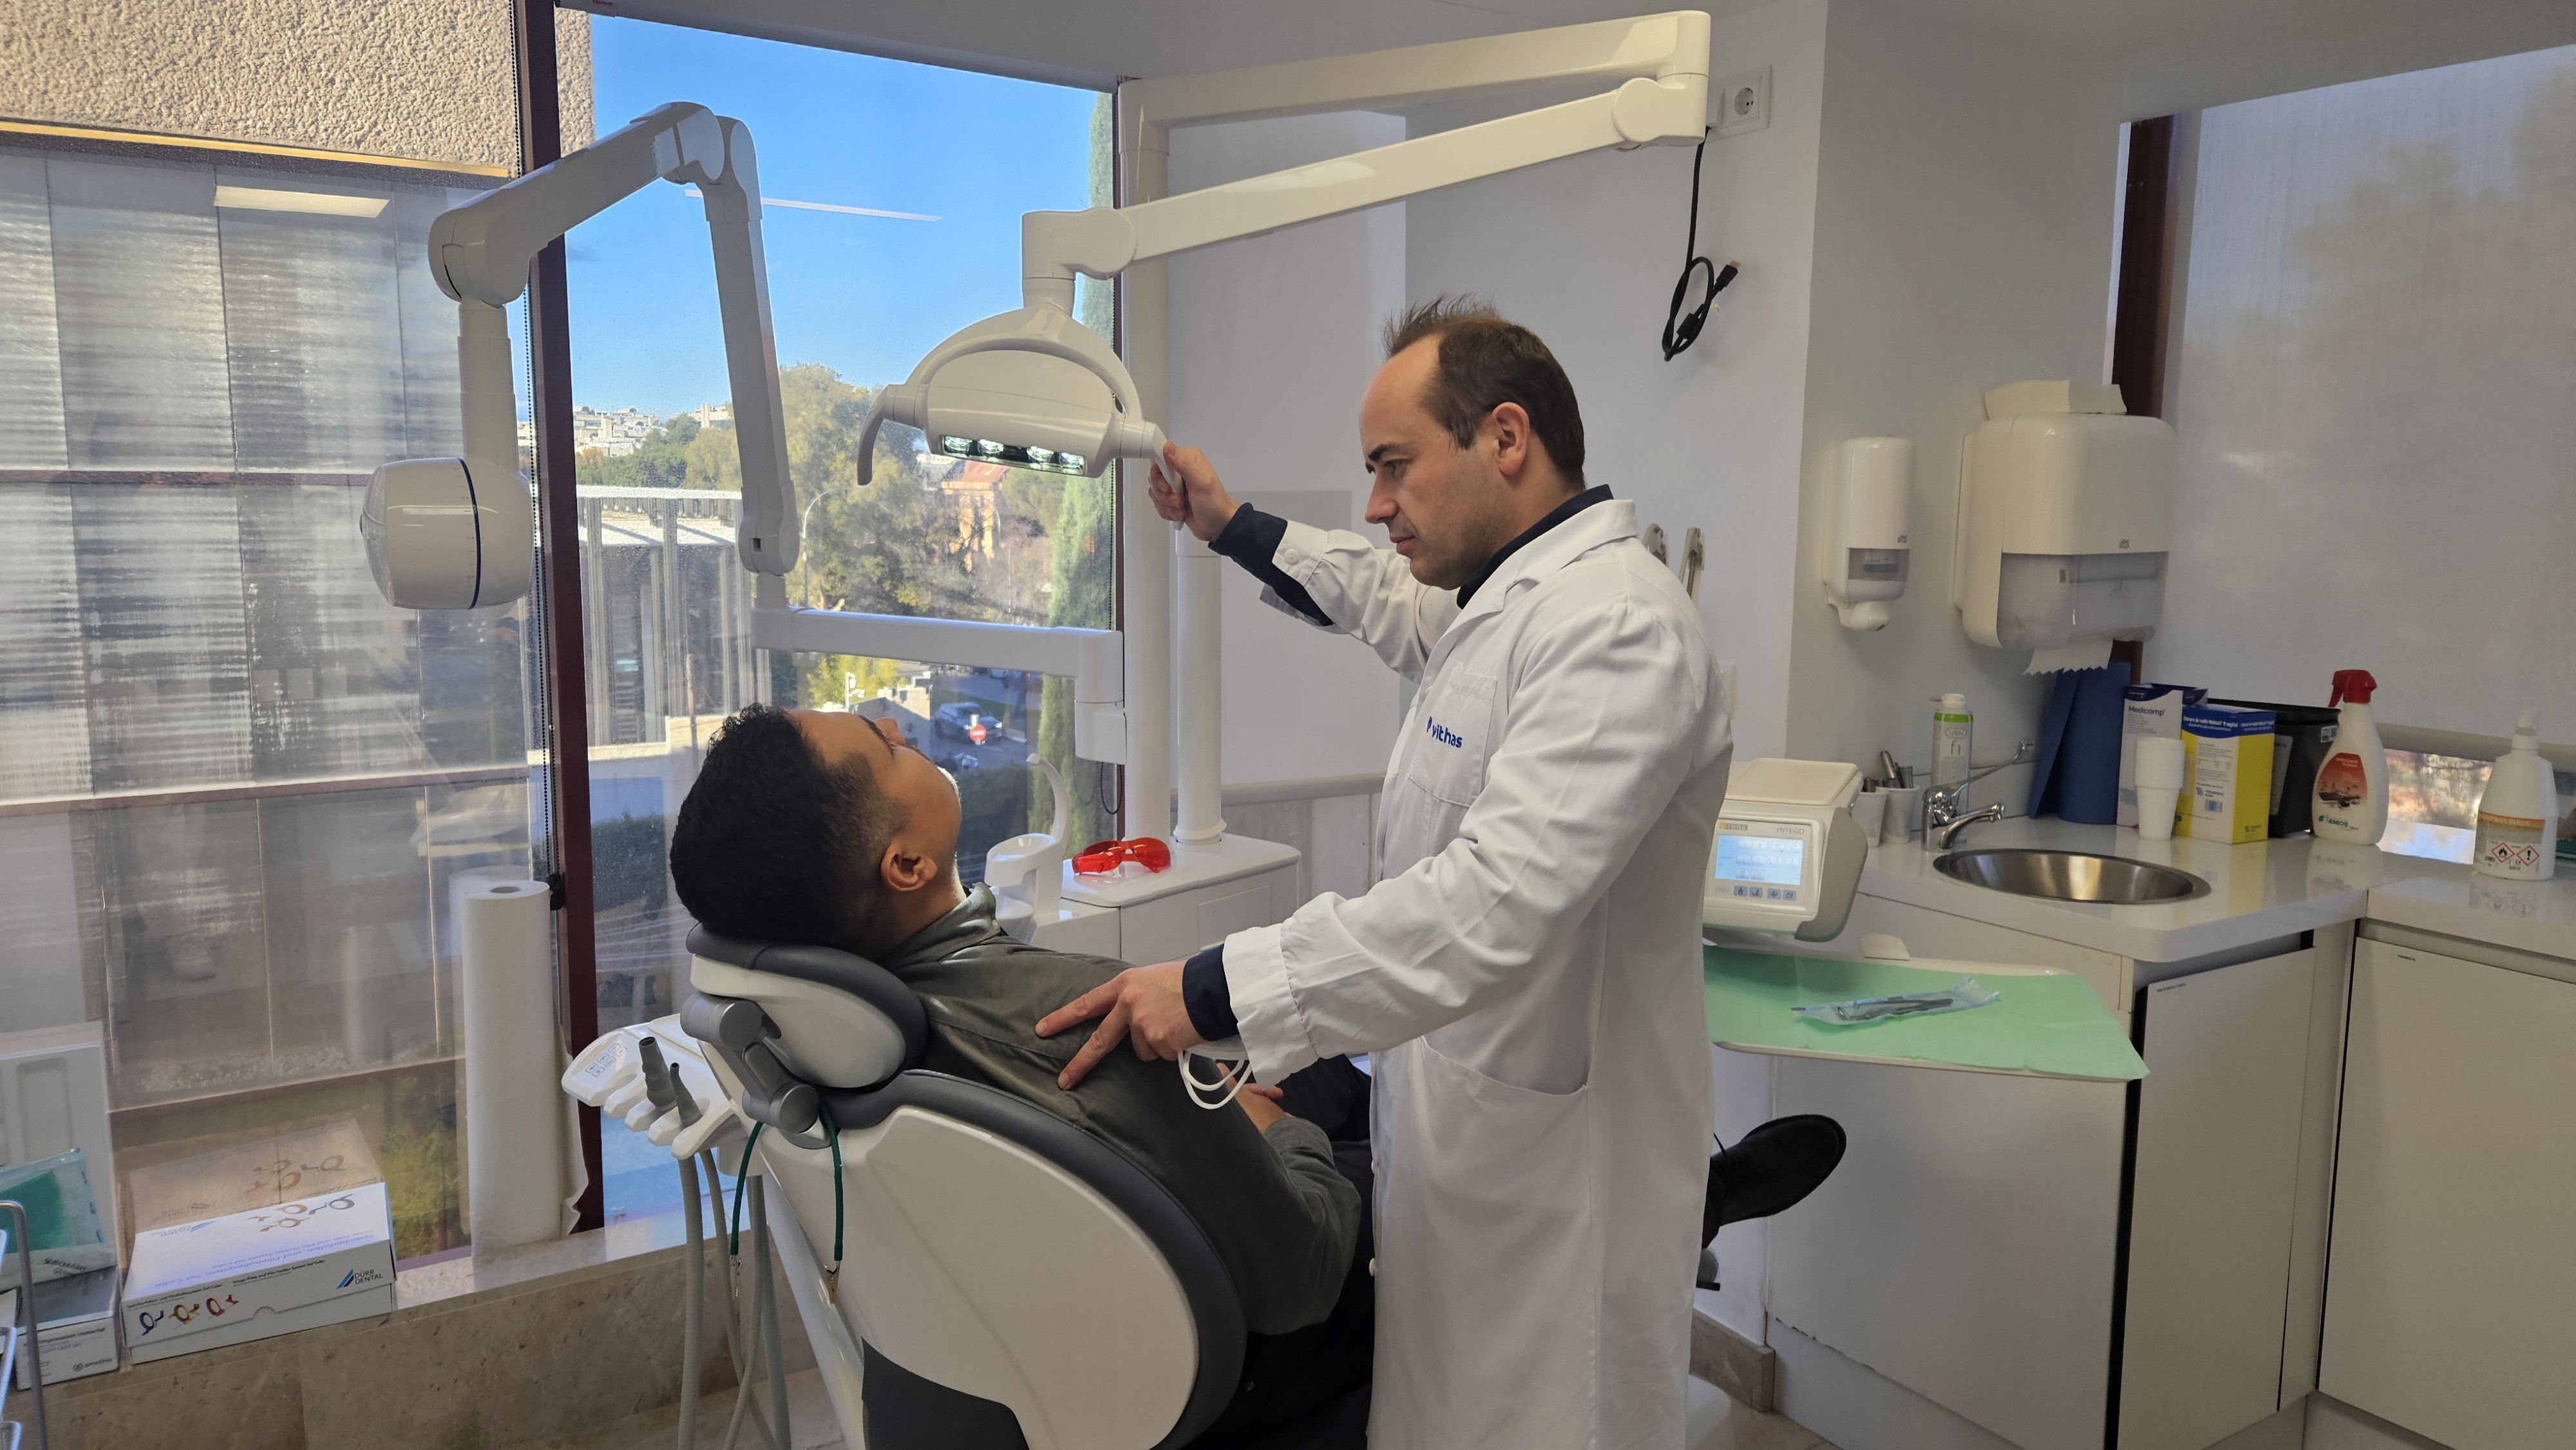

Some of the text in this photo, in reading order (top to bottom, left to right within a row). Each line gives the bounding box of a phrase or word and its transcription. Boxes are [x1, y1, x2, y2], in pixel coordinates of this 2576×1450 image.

[1432, 724, 1463, 748] vithas
[354, 1269, 375, 1279] DÜRR
[355, 1274, 383, 1285] DENTAL
